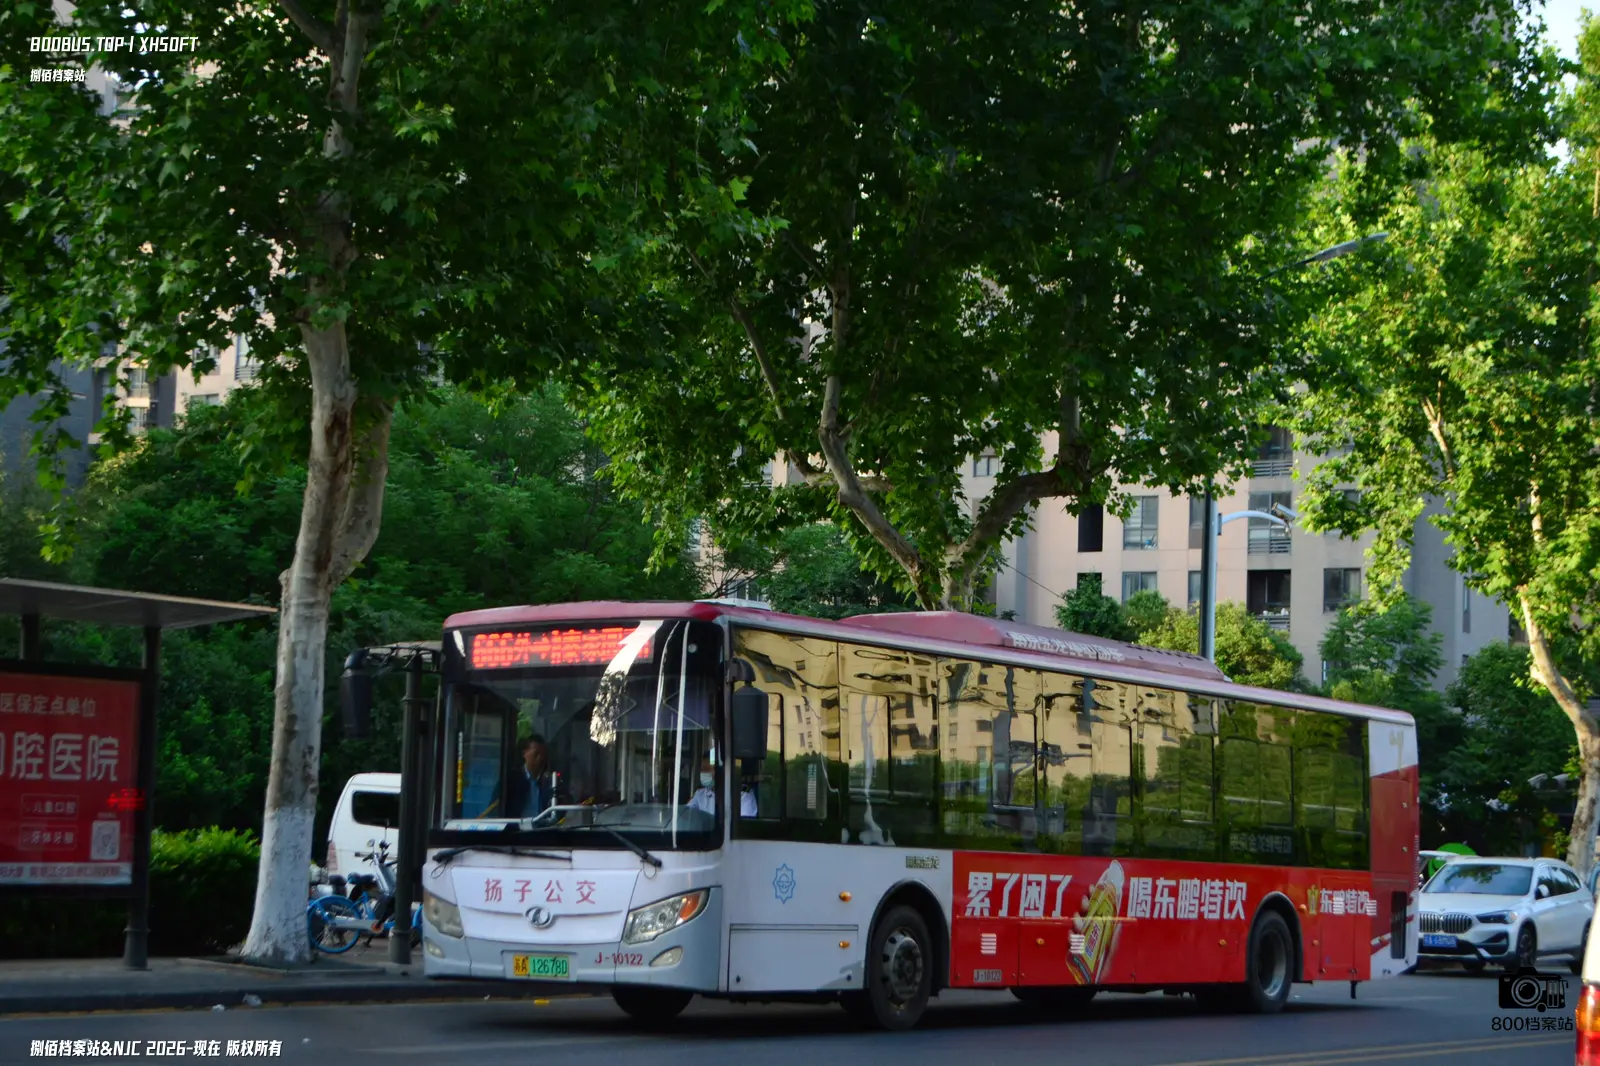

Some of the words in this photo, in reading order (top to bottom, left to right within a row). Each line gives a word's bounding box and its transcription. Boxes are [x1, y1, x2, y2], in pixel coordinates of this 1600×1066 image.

[0, 731, 119, 782] 腔医院
[484, 878, 596, 905] 扬子公交
[965, 871, 1073, 918] 累了困了
[1127, 876, 1248, 921] 喝东鹏特饮
[594, 951, 643, 966] J-10122
